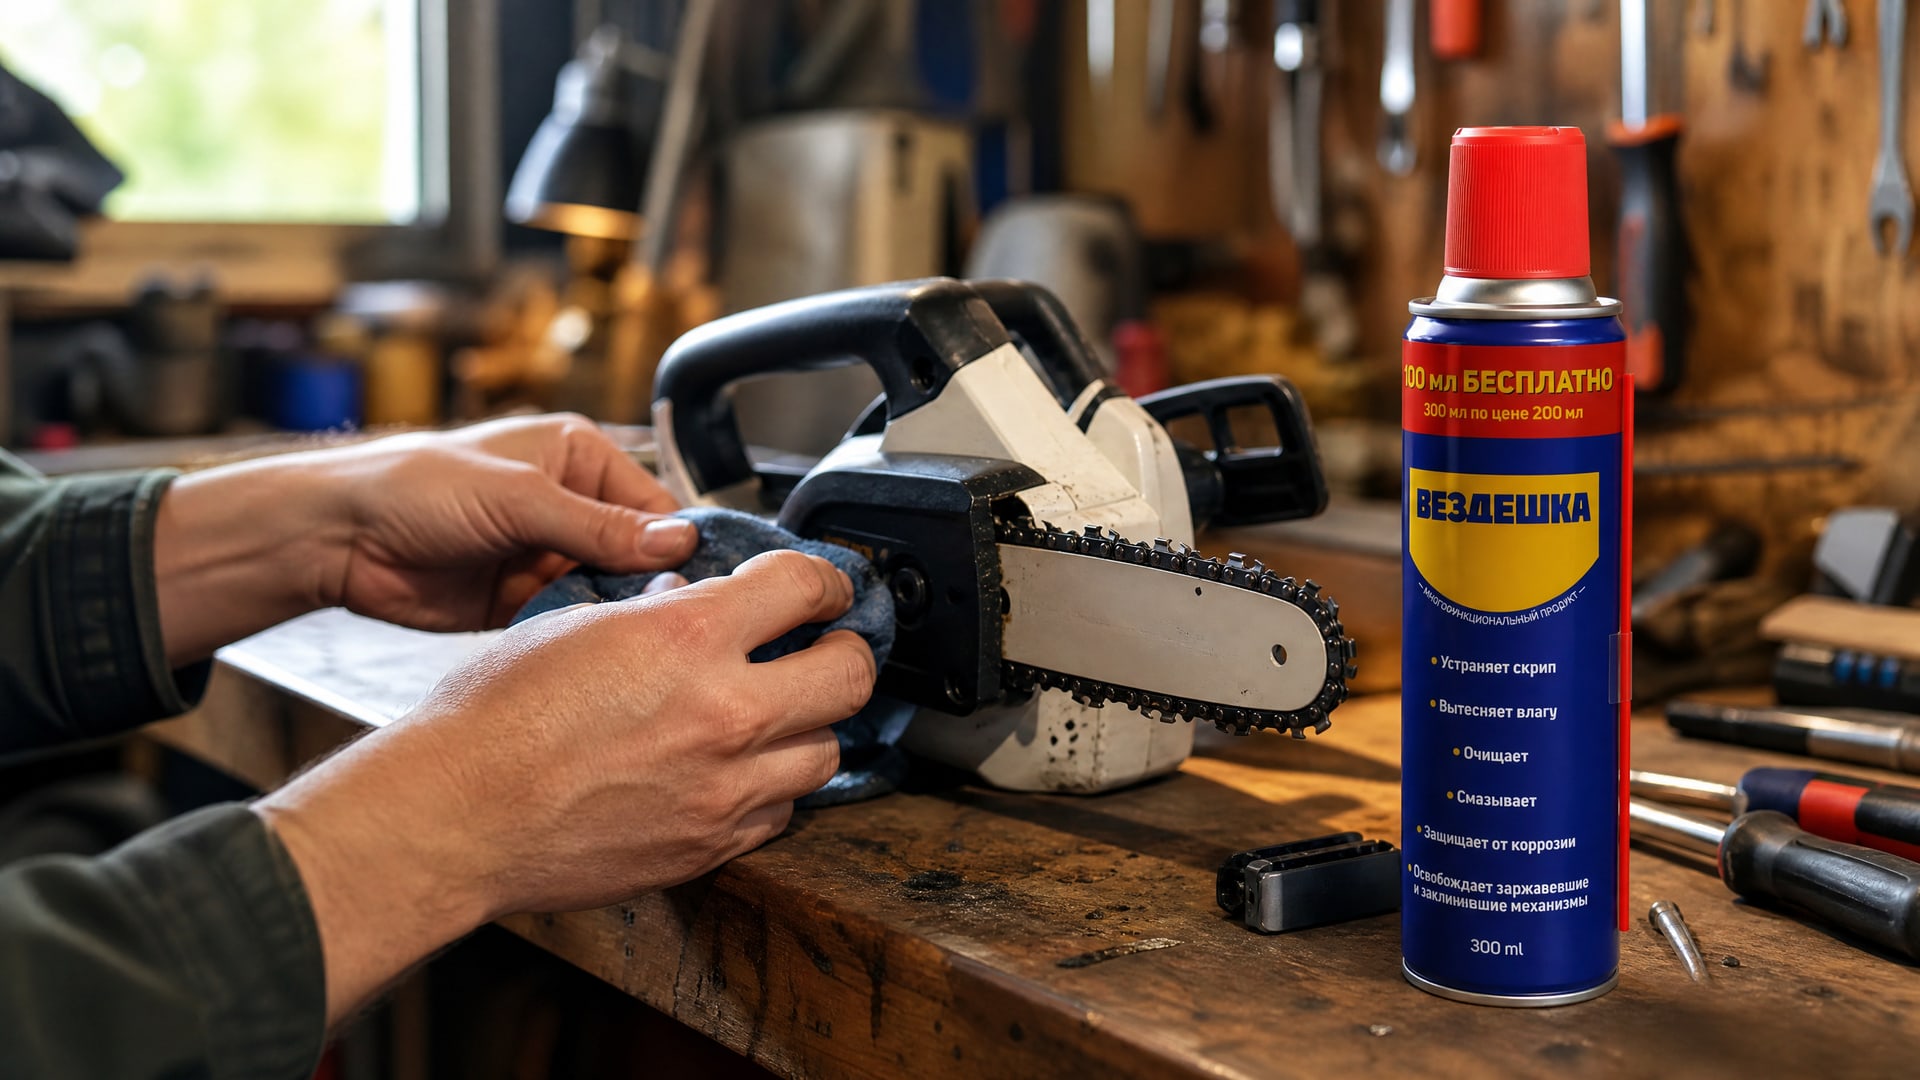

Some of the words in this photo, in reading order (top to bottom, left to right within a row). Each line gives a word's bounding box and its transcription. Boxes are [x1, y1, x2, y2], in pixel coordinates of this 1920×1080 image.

[1404, 364, 1425, 390] 100
[1430, 374, 1457, 392] мл
[1464, 367, 1613, 394] БЕСПЛАТНО
[1424, 403, 1446, 418] 300
[1450, 408, 1467, 419] мл
[1471, 408, 1488, 419] по
[1492, 410, 1529, 422] цене
[1533, 406, 1562, 420] 200
[1566, 407, 1584, 419] мл
[1417, 488, 1591, 524] ВЕЗДЕШКА
[1540, 591, 1578, 618] ПРОДУКТ
[1441, 655, 1509, 674] Устраняет
[1513, 662, 1556, 677] скрип
[1439, 699, 1513, 718] Вытесняет
[1517, 706, 1557, 720] влагу
[1464, 746, 1529, 763] Очищает
[1457, 790, 1537, 807] Смазывает
[1424, 825, 1488, 849] Защищает
[1492, 841, 1508, 850] от
[1511, 837, 1576, 854] коррозии
[1414, 864, 1493, 893] Освобождает
[1496, 878, 1589, 898] заржавевшие
[1414, 884, 1419, 895] и
[1511, 895, 1588, 912] механизмы
[1470, 939, 1501, 955] 300
[1505, 942, 1524, 956] ml
